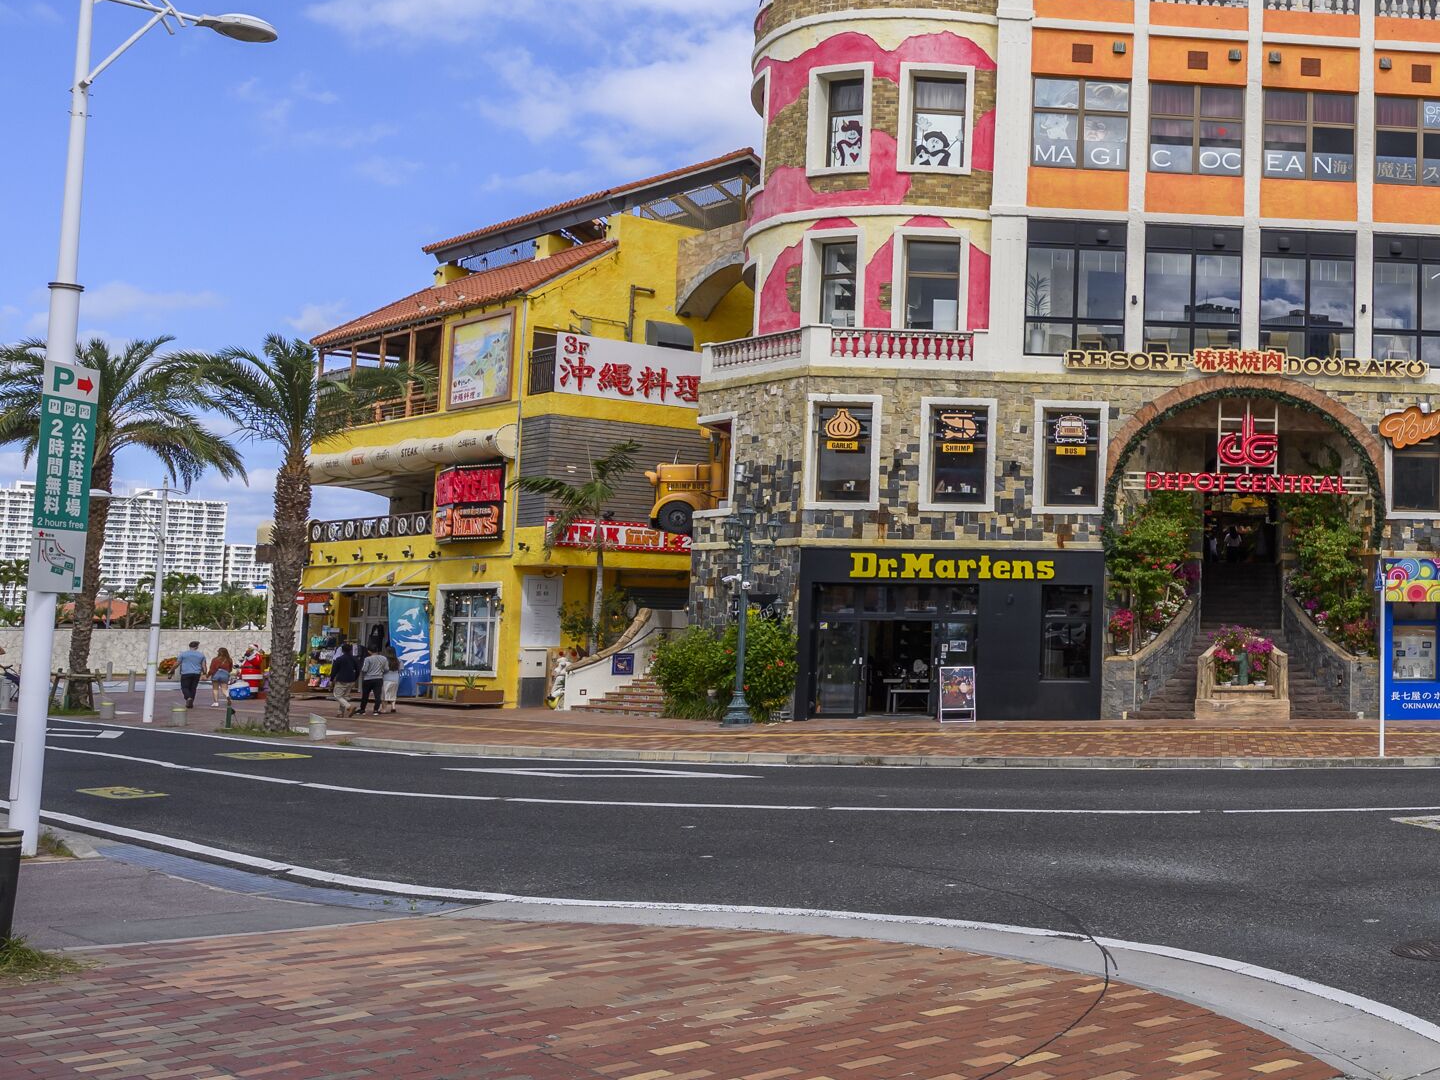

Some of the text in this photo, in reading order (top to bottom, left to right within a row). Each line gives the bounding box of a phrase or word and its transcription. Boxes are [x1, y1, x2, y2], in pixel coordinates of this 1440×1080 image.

[1034, 144, 1172, 167] MAGIC
[564, 335, 590, 355] 3F
[1067, 350, 1190, 371] RESORT
[1193, 349, 1283, 372] 琉球焼肉
[53, 366, 75, 392] P
[560, 356, 701, 402] 沖縄料理
[401, 447, 418, 458] STEAK
[831, 442, 853, 450] GARLIC
[945, 444, 971, 453] SHRIMP
[1064, 447, 1078, 455] BUS
[43, 418, 65, 515] 2時間無料
[65, 422, 88, 517] 公共駐車場
[1145, 471, 1349, 494] DEPOT CENTRAL
[37, 517, 84, 529] 2 hours free
